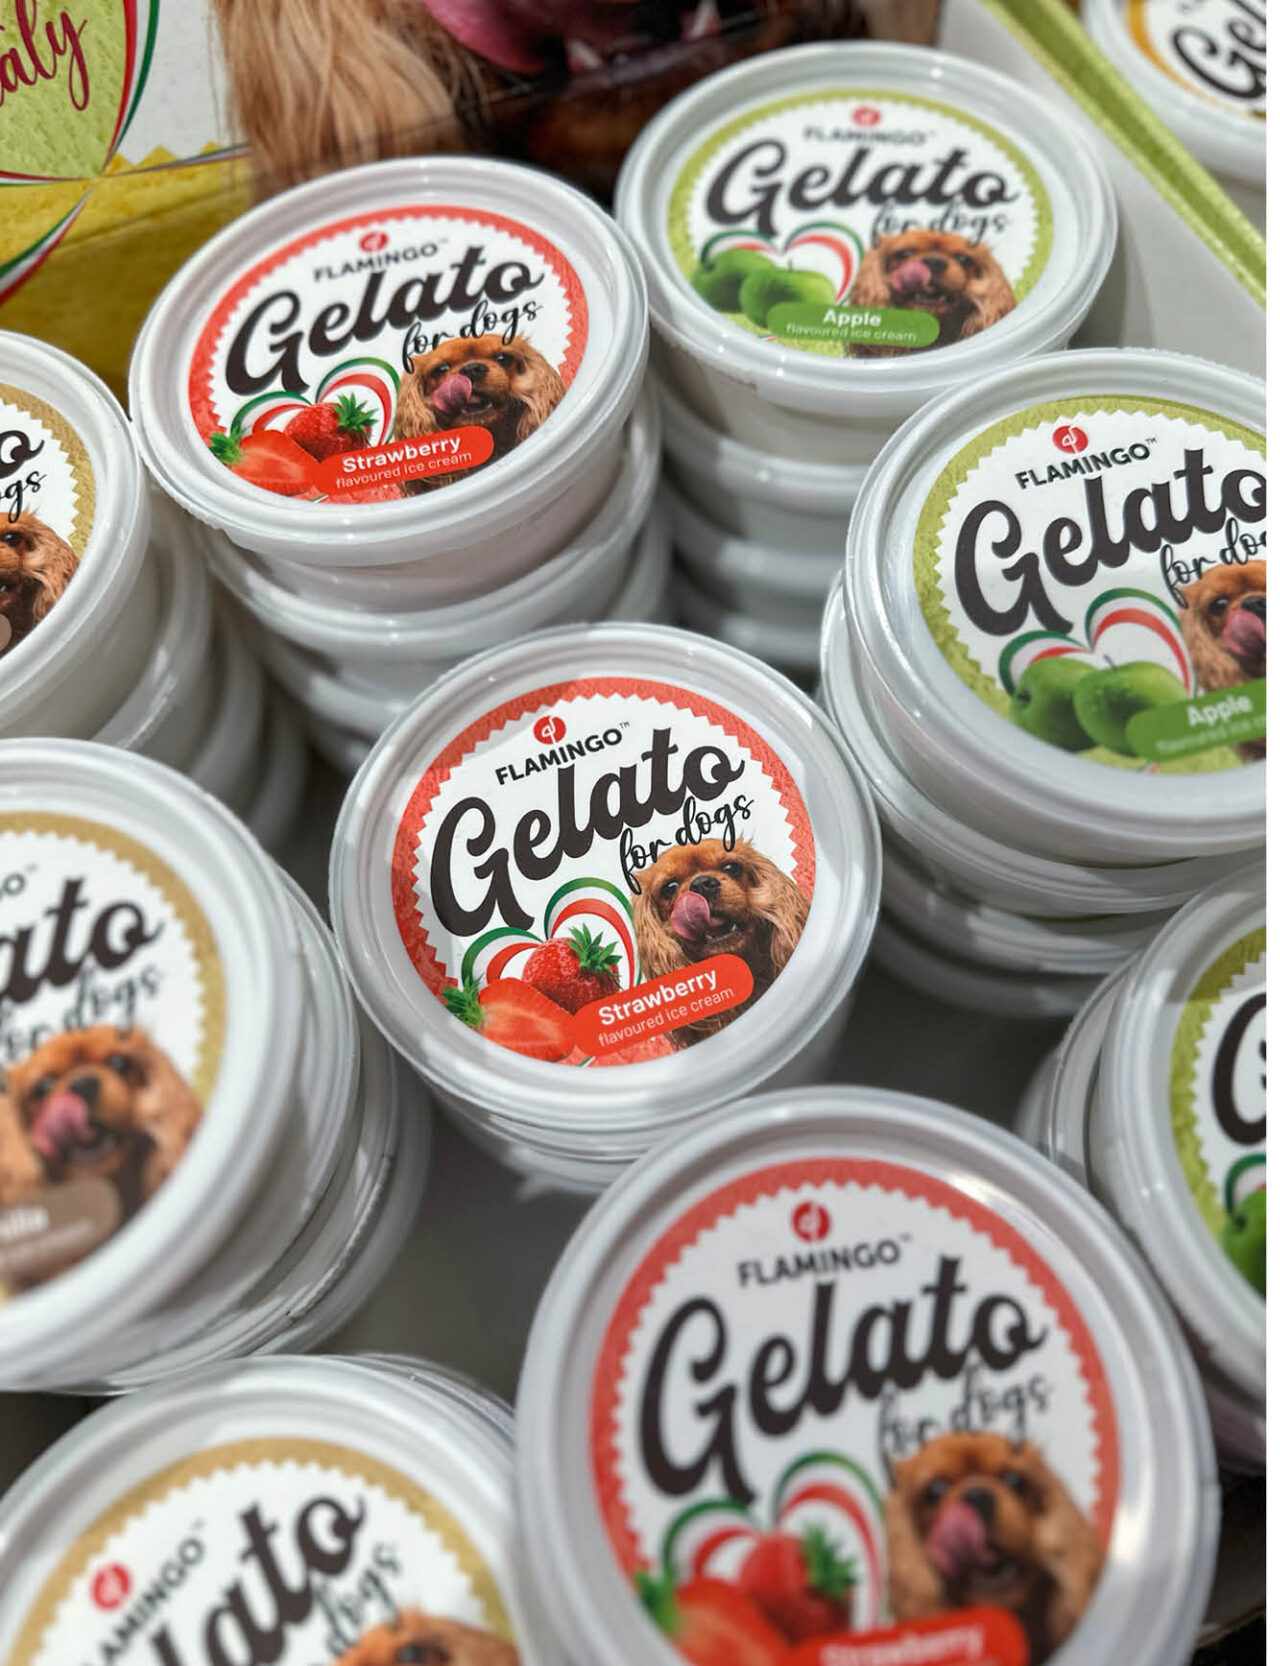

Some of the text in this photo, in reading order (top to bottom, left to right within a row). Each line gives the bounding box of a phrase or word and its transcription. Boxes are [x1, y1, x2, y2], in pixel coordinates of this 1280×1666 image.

[705, 138, 1020, 238] Gelato
[870, 199, 1012, 248] for dogs
[226, 245, 545, 397] Gelato
[401, 299, 545, 374] for dogs
[785, 323, 918, 343] flavoured ice cream
[822, 308, 882, 329] Apple
[335, 450, 473, 491] flavoured ice cream
[342, 435, 462, 475] Strawberry
[954, 448, 1266, 637] Gelato
[1160, 516, 1266, 609] for do
[1187, 694, 1254, 728] Apple
[430, 727, 746, 938] Gelato
[619, 793, 755, 895] for dogs
[598, 966, 718, 1026] Strawberry
[598, 987, 735, 1048] flavoured ice cream
[737, 1238, 901, 1289] FLAMINGO
[637, 1254, 1048, 1507] Gelato
[948, 1358, 1057, 1453] dogs
[97, 1536, 206, 1666] AMINGO
